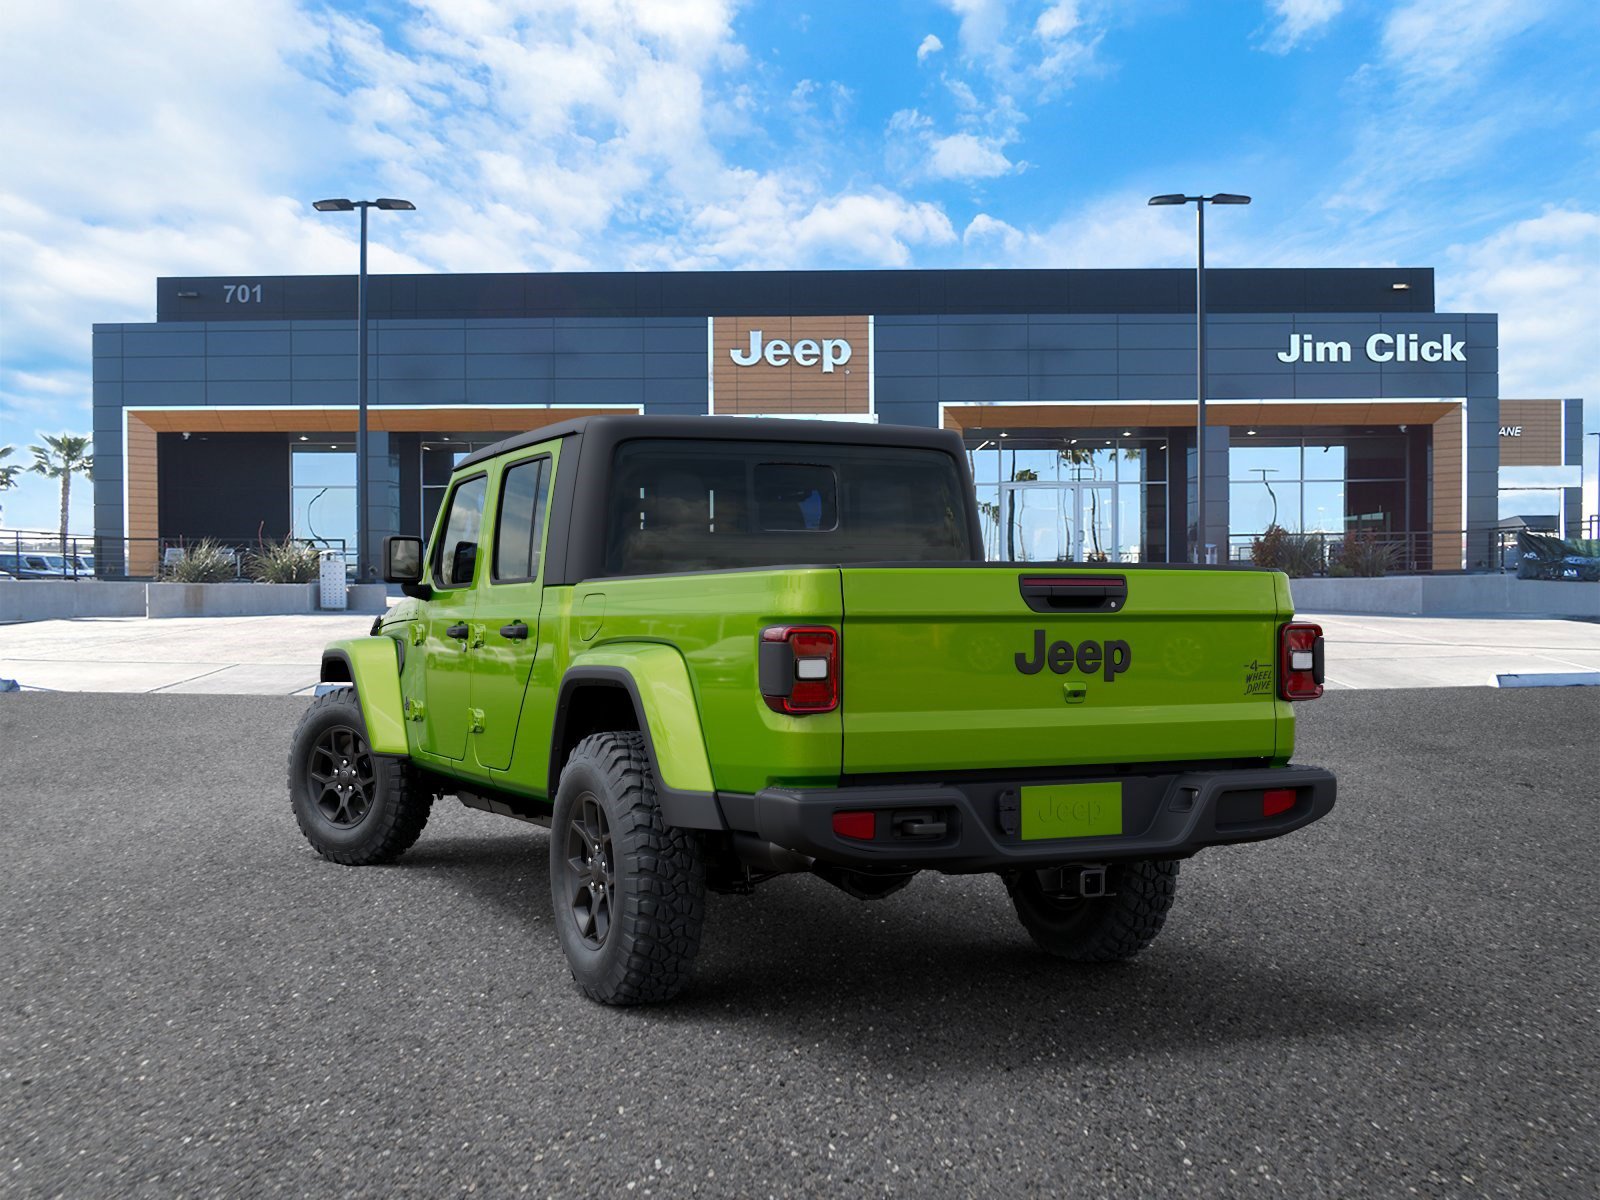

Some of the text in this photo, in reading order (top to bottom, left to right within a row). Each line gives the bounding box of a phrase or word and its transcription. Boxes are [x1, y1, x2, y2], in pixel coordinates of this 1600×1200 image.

[223, 284, 262, 303] 701
[729, 330, 852, 373] Jeep
[1277, 333, 1467, 362] Jim Click
[1014, 629, 1132, 682] Jeep
[1249, 660, 1258, 671] 4
[1245, 670, 1273, 684] WHEEL
[1246, 680, 1272, 694] DRIVE
[1038, 794, 1103, 827] Jeep
